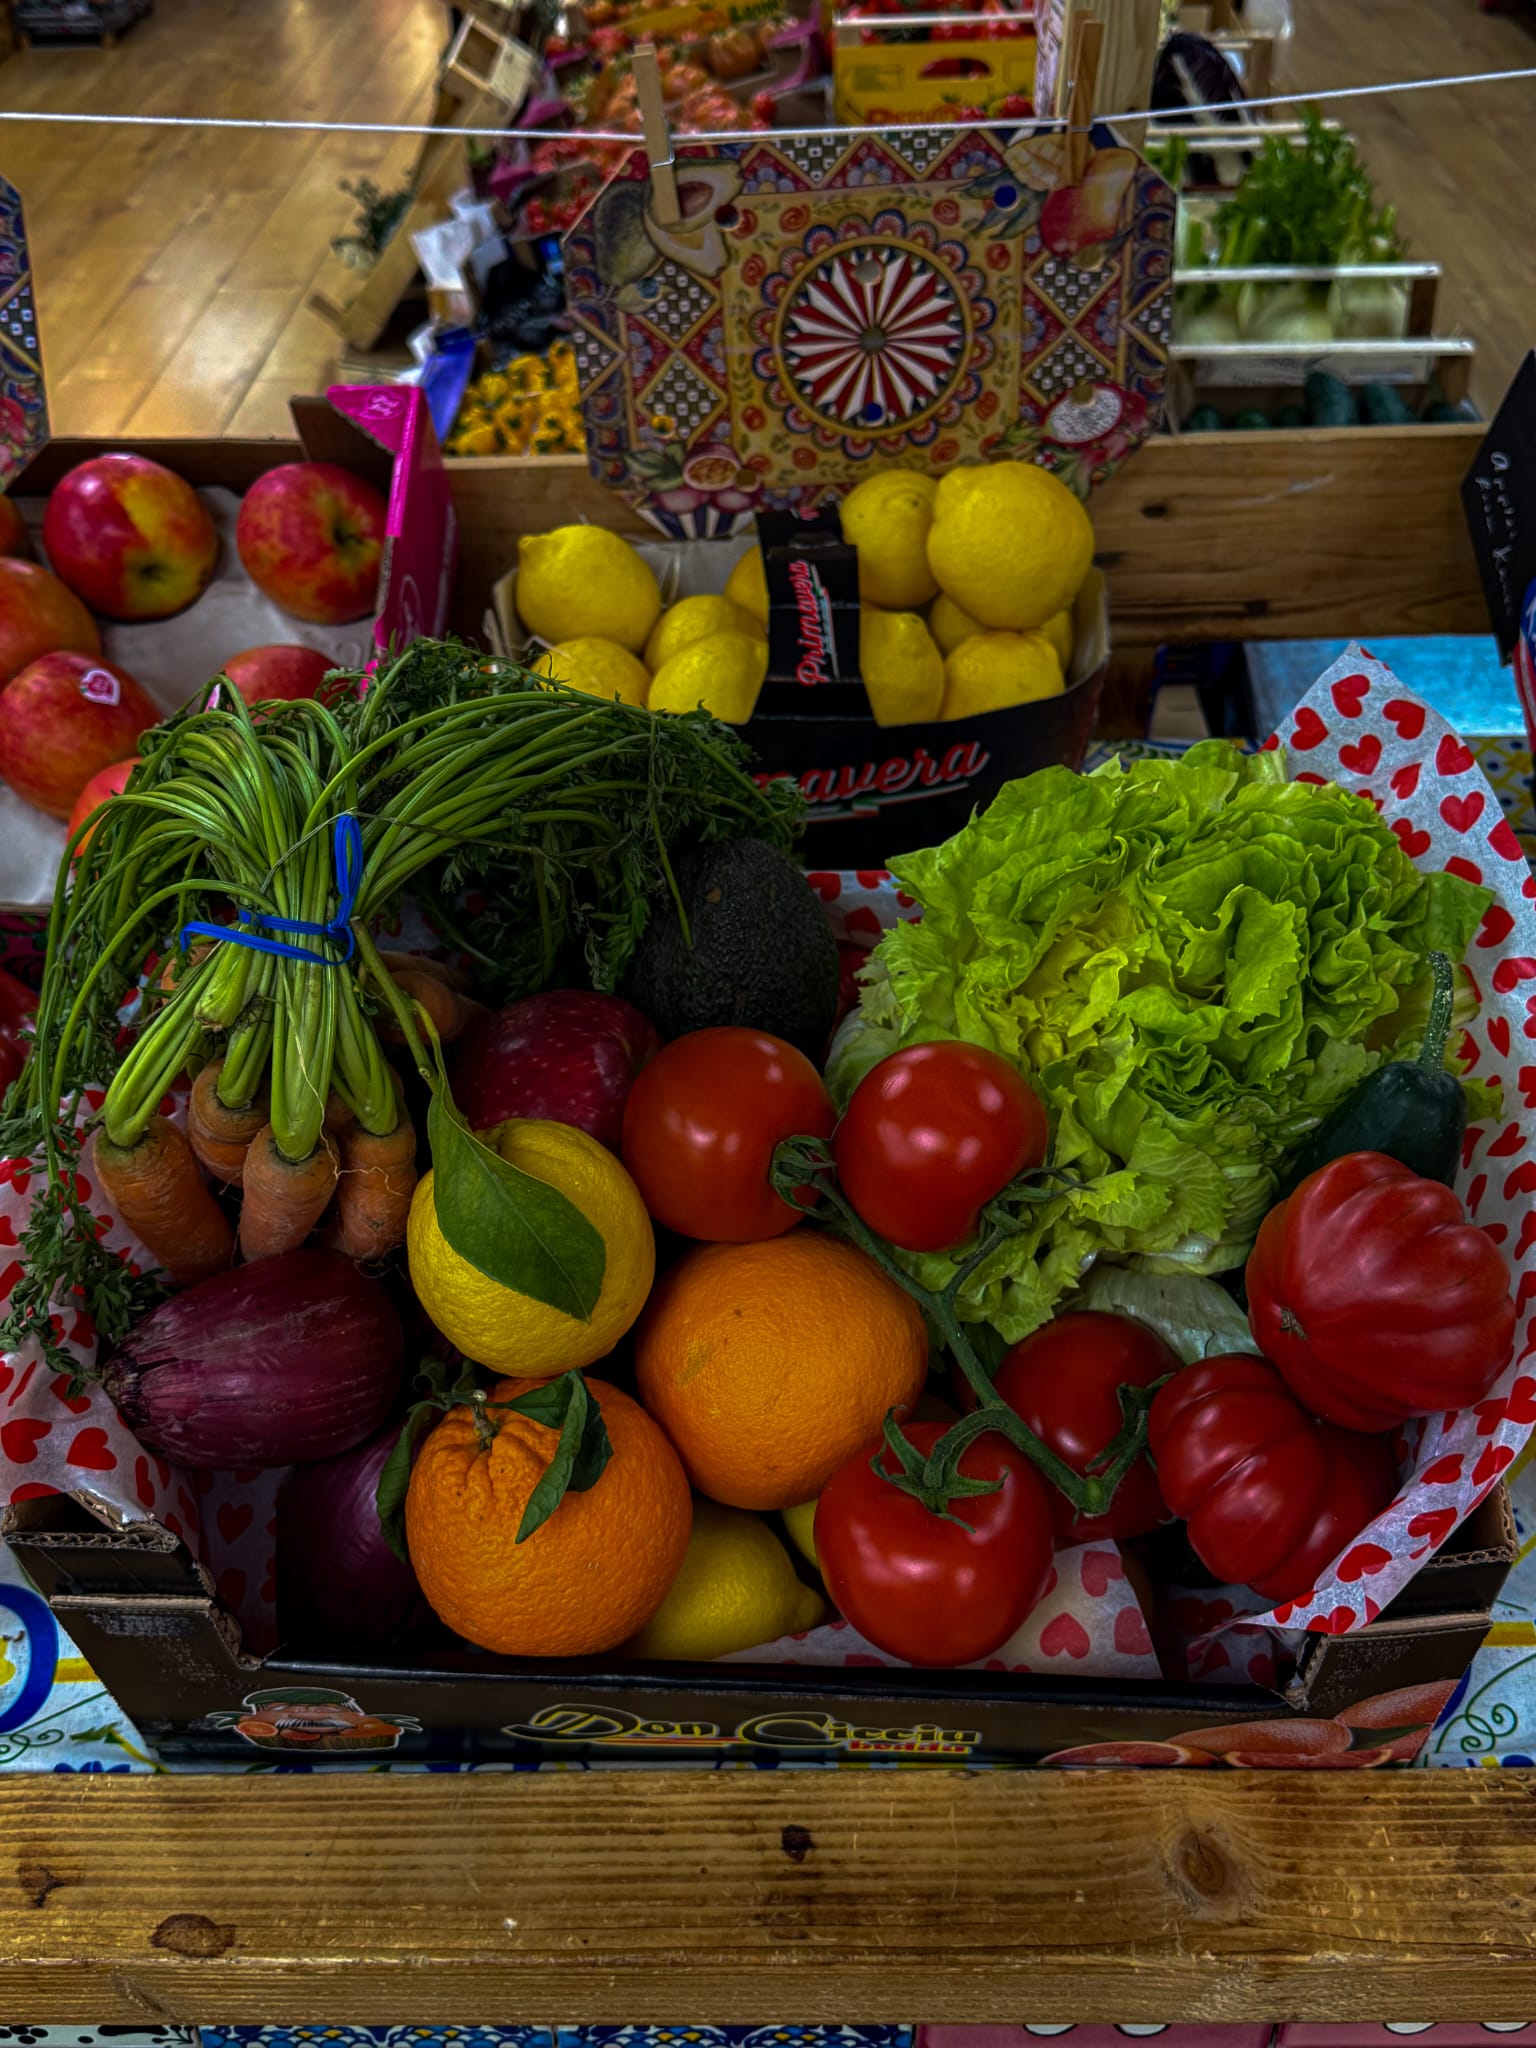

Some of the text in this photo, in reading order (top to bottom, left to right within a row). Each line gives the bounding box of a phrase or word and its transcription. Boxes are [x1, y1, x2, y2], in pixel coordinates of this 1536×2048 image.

[787, 559, 830, 687] Primavera
[752, 741, 990, 803] avera
[500, 1703, 719, 1742] Don
